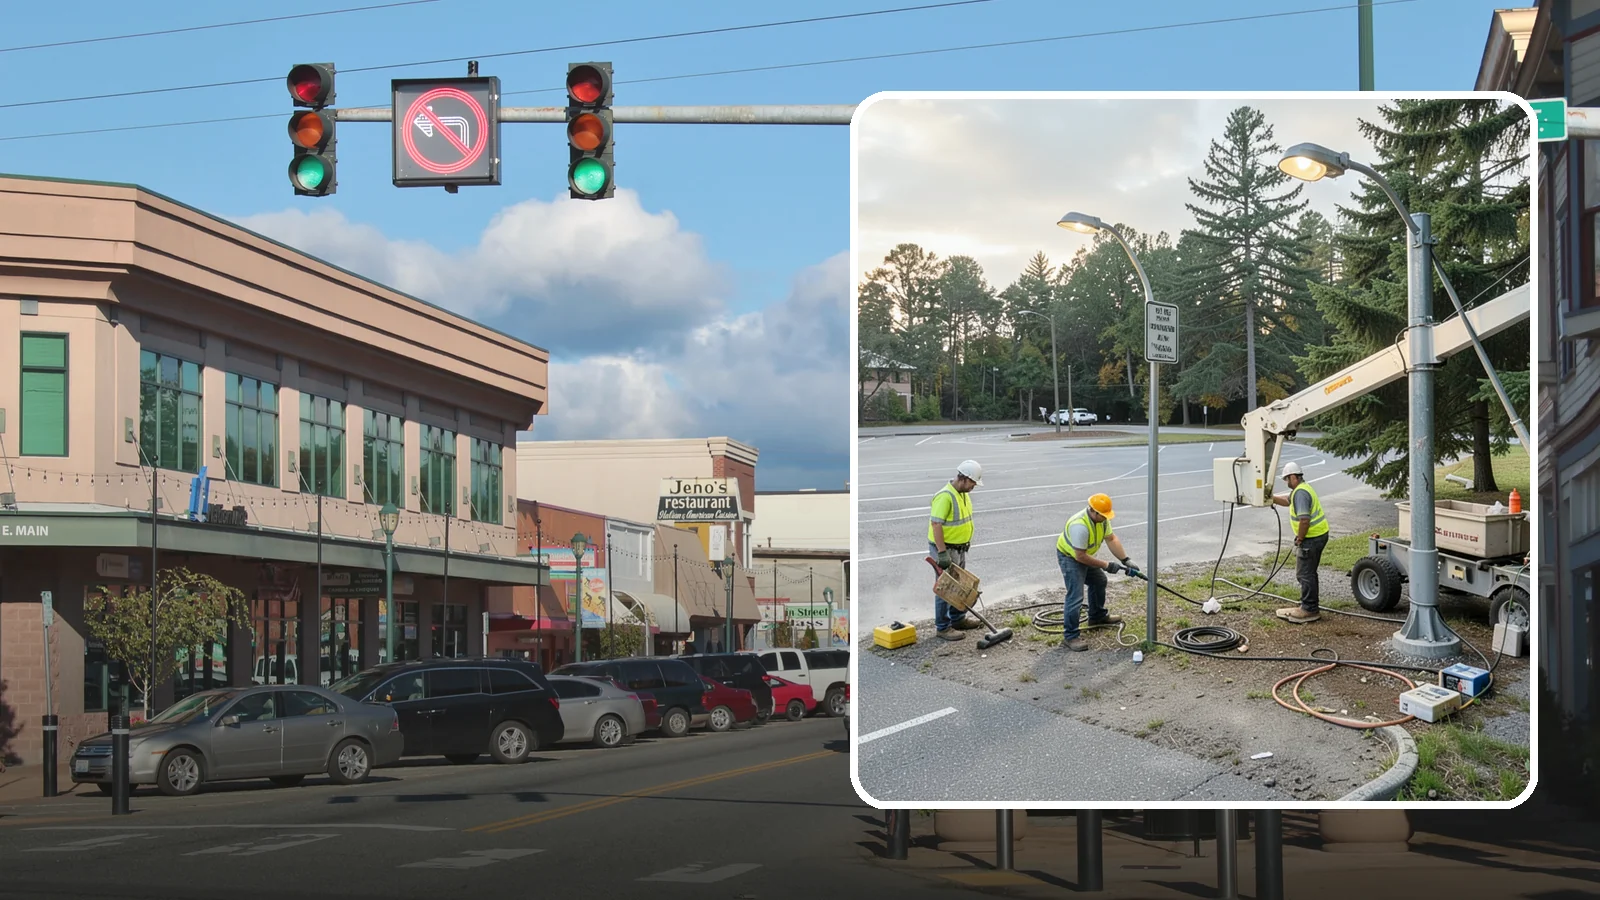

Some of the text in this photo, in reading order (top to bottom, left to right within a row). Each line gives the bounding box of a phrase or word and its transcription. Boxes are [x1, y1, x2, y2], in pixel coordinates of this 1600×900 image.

[670, 480, 727, 494] Jeno's
[665, 496, 731, 509] restaurant
[658, 510, 682, 520] Italian
[686, 509, 715, 520] American
[715, 509, 738, 520] Cuisine
[2, 525, 49, 536] E. MAIN
[797, 607, 828, 616] Street
[790, 619, 824, 627] lass
